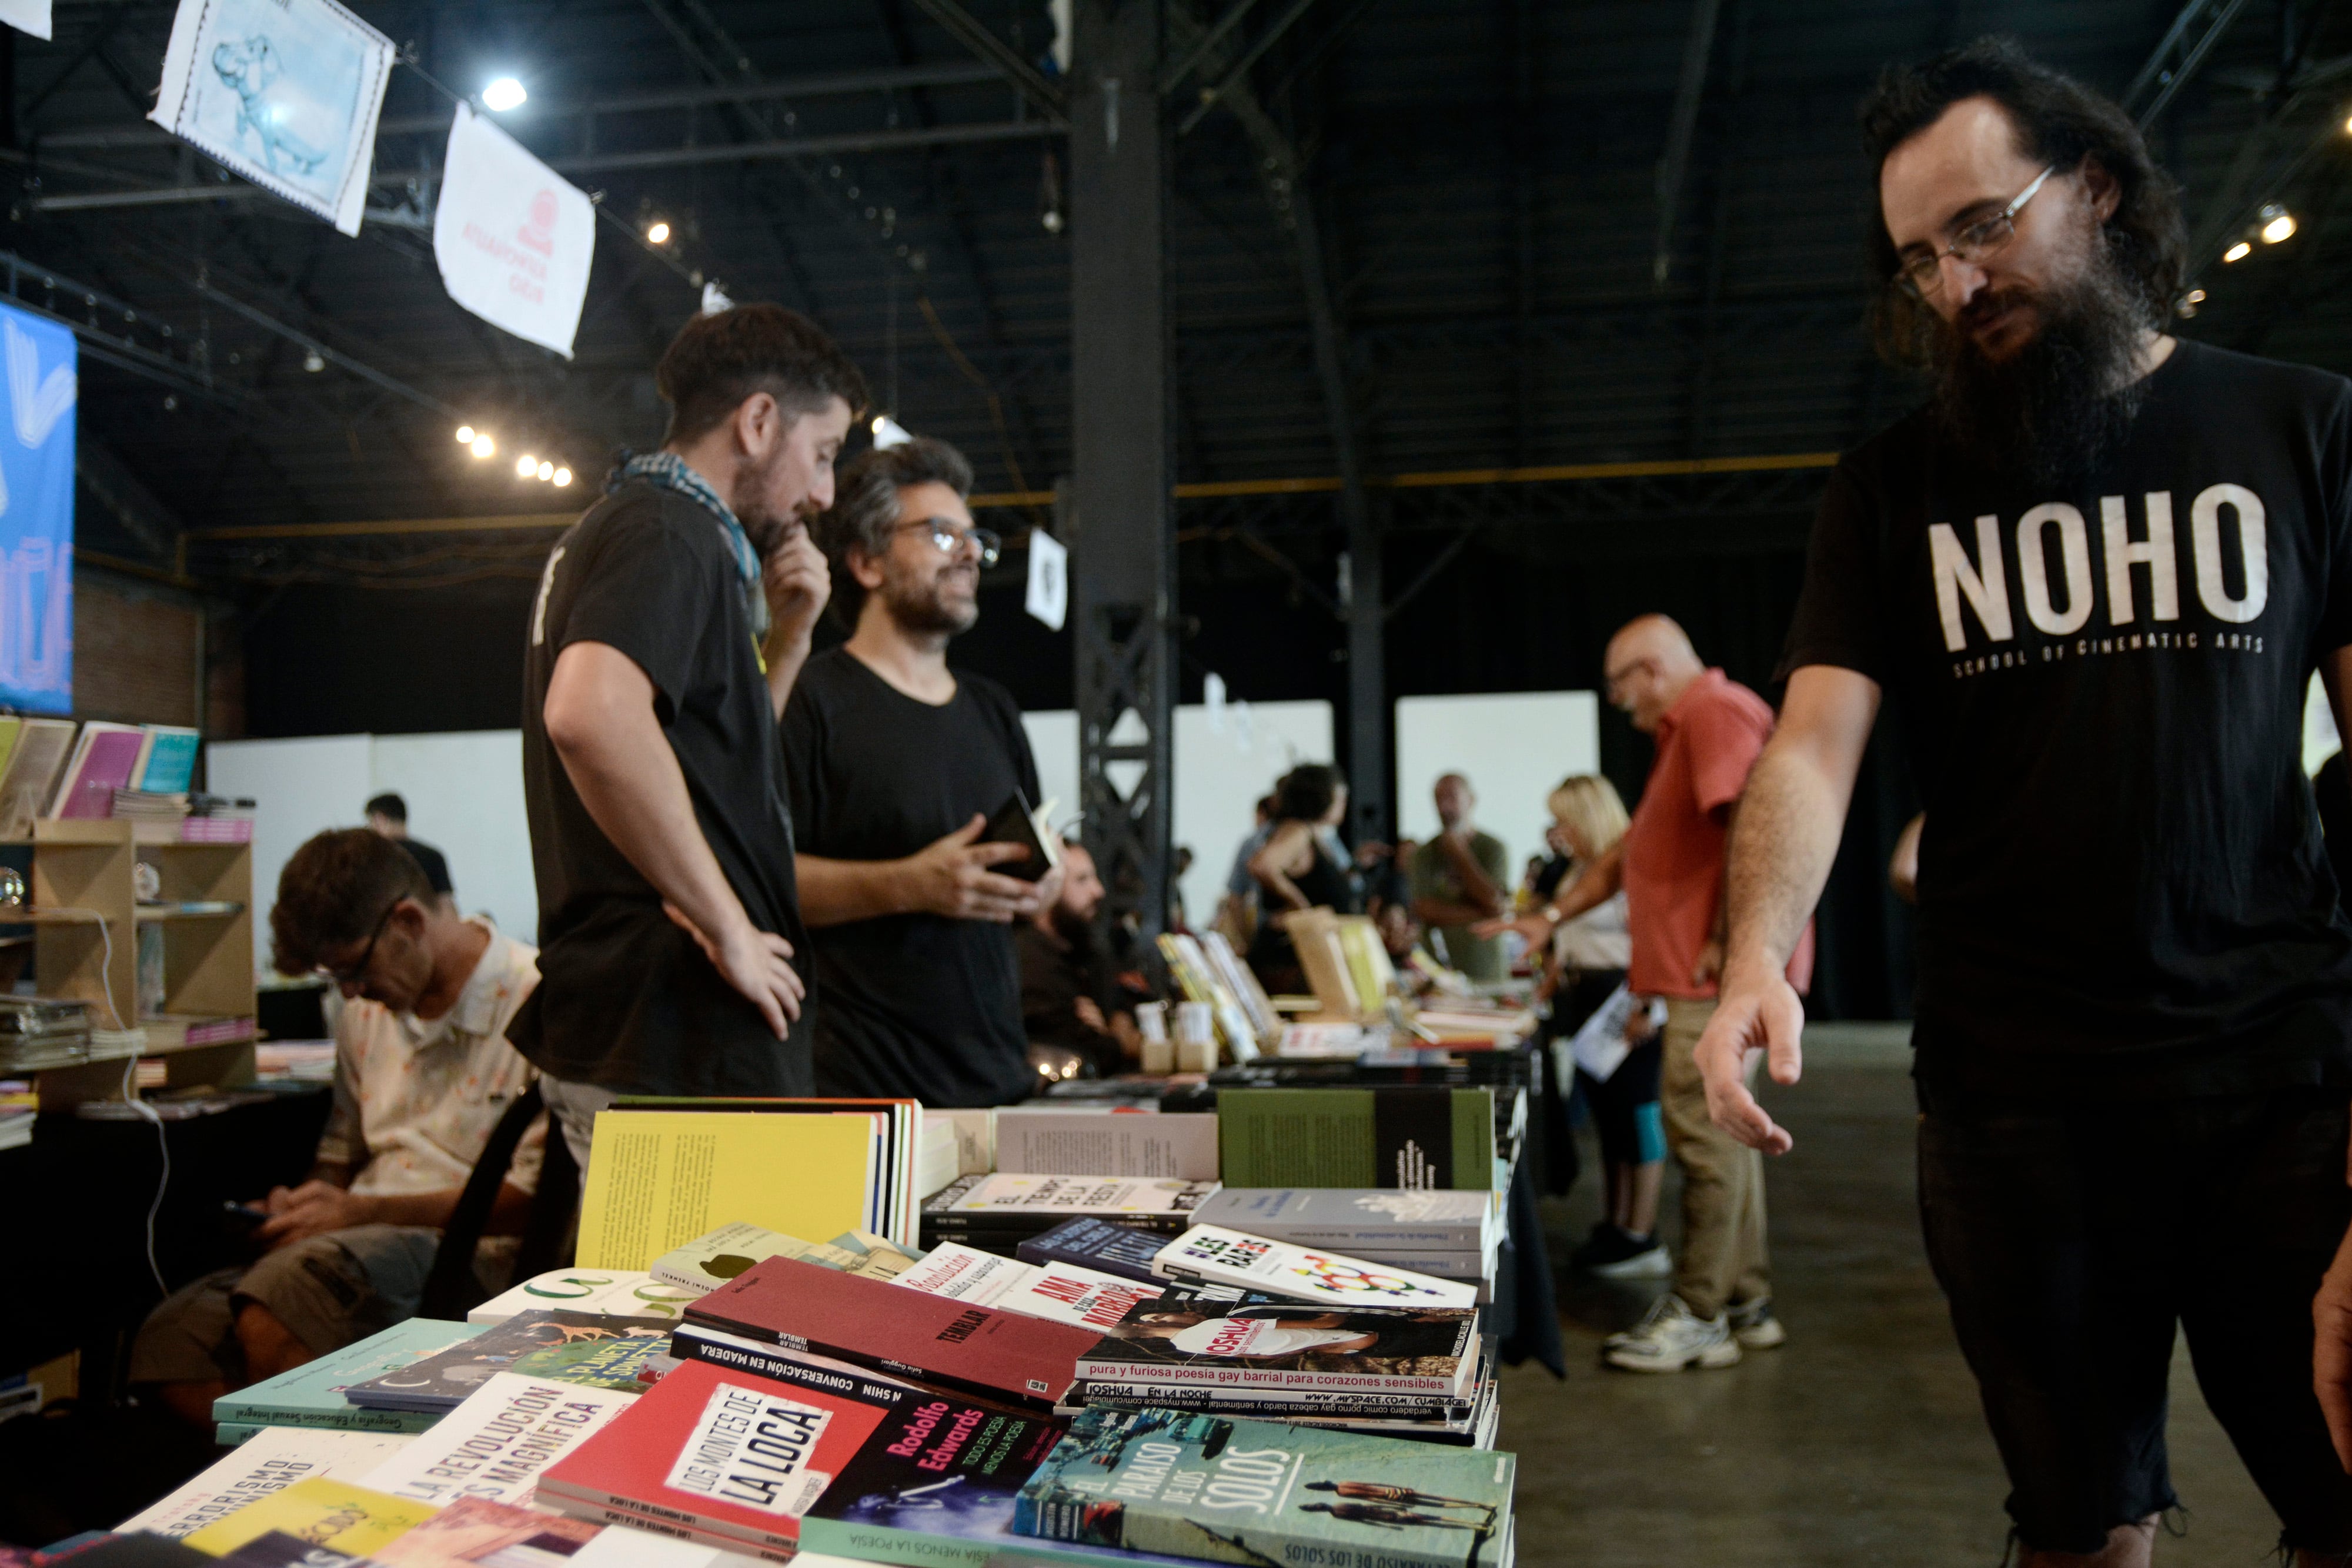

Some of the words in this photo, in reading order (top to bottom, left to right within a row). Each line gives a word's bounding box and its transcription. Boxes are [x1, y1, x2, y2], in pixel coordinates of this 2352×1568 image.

[1928, 483, 2268, 652] NOHO
[1953, 650, 2027, 678] SCHOOL
[2042, 646, 2064, 661] OF
[2077, 633, 2197, 655] CINEMATIC
[2216, 633, 2264, 654] ARTS
[661, 1272, 690, 1285] FRENKEL
[906, 1253, 977, 1292] Revolución
[1031, 1275, 1095, 1304] AMA
[936, 1310, 992, 1343] TEMBLAR
[779, 1332, 807, 1345] TEMBLAR
[780, 1340, 808, 1352] TEMBLAR
[566, 1341, 646, 1373] PLANETA
[700, 1344, 747, 1365] MADERA
[749, 1356, 765, 1369] EN
[767, 1360, 853, 1391] CONVERSACIÓN
[1090, 1364, 1116, 1376] pura
[1120, 1368, 1126, 1377] y
[1130, 1365, 1171, 1378] furiosa
[1175, 1368, 1215, 1381] poesía
[1219, 1371, 1240, 1383] gay
[1244, 1370, 1283, 1383] barrial
[1287, 1374, 1313, 1385] para
[1317, 1376, 1381, 1388] corazones
[1385, 1376, 1445, 1390] sensibles
[863, 1383, 891, 1400] SHIN
[1148, 1386, 1161, 1396] EN
[1164, 1389, 1175, 1398] LA
[1180, 1389, 1212, 1399] NOCHE
[723, 1391, 764, 1416] DE
[1209, 1399, 1255, 1410] sentimental
[1255, 1401, 1261, 1409] y
[1264, 1401, 1288, 1410] bardo
[1290, 1402, 1319, 1412] cabeza
[1321, 1402, 1336, 1413] gay
[1338, 1403, 1361, 1413] porno
[1363, 1406, 1388, 1415] comic
[1390, 1406, 1432, 1415] verdadero
[236, 1407, 269, 1420] Integral
[271, 1410, 301, 1422] Sexual
[303, 1412, 348, 1425] Educación
[359, 1413, 401, 1429] Geografía
[886, 1402, 950, 1457] Rodolfo
[983, 1416, 1007, 1439] POESÍA
[1003, 1420, 1028, 1442] POESÍA
[393, 1481, 452, 1499] LA
[425, 1386, 564, 1480] REVOLUCIÓN
[479, 1402, 604, 1485] MAGNÍFICA
[691, 1413, 750, 1472] MONTES
[739, 1406, 823, 1472] LOCA
[917, 1409, 984, 1472] Edwards
[977, 1436, 993, 1446] ES
[998, 1440, 1010, 1451] LA
[962, 1445, 985, 1466] TODO
[981, 1447, 1007, 1475] MENOS
[678, 1465, 720, 1492] LOS
[1111, 1442, 1182, 1500] PARAISO
[1174, 1469, 1208, 1489] LOS
[1200, 1446, 1291, 1514] SOLOS
[719, 1472, 784, 1506] LA
[1071, 1480, 1109, 1495] EL
[1161, 1485, 1197, 1505] DE
[159, 1460, 290, 1537] ERRORISMO
[609, 1496, 626, 1508] LOCA
[627, 1502, 637, 1512] LA
[639, 1505, 650, 1514] DE
[651, 1507, 680, 1522] MONTES
[604, 1510, 622, 1522] LOCA
[622, 1515, 633, 1525] LA
[681, 1514, 696, 1524] LOS
[634, 1519, 646, 1529] DE
[646, 1522, 675, 1536] MONTES
[676, 1530, 691, 1539] LOS
[850, 1532, 893, 1549] POESÍA
[897, 1537, 913, 1550] LA
[915, 1539, 962, 1556] MENOS
[761, 1551, 787, 1564] WAGNER
[965, 1546, 991, 1561] ESÍA
[1286, 1544, 1325, 1563] SOLOS
[1329, 1549, 1352, 1567] LOS
[1355, 1553, 1372, 1568] DE
